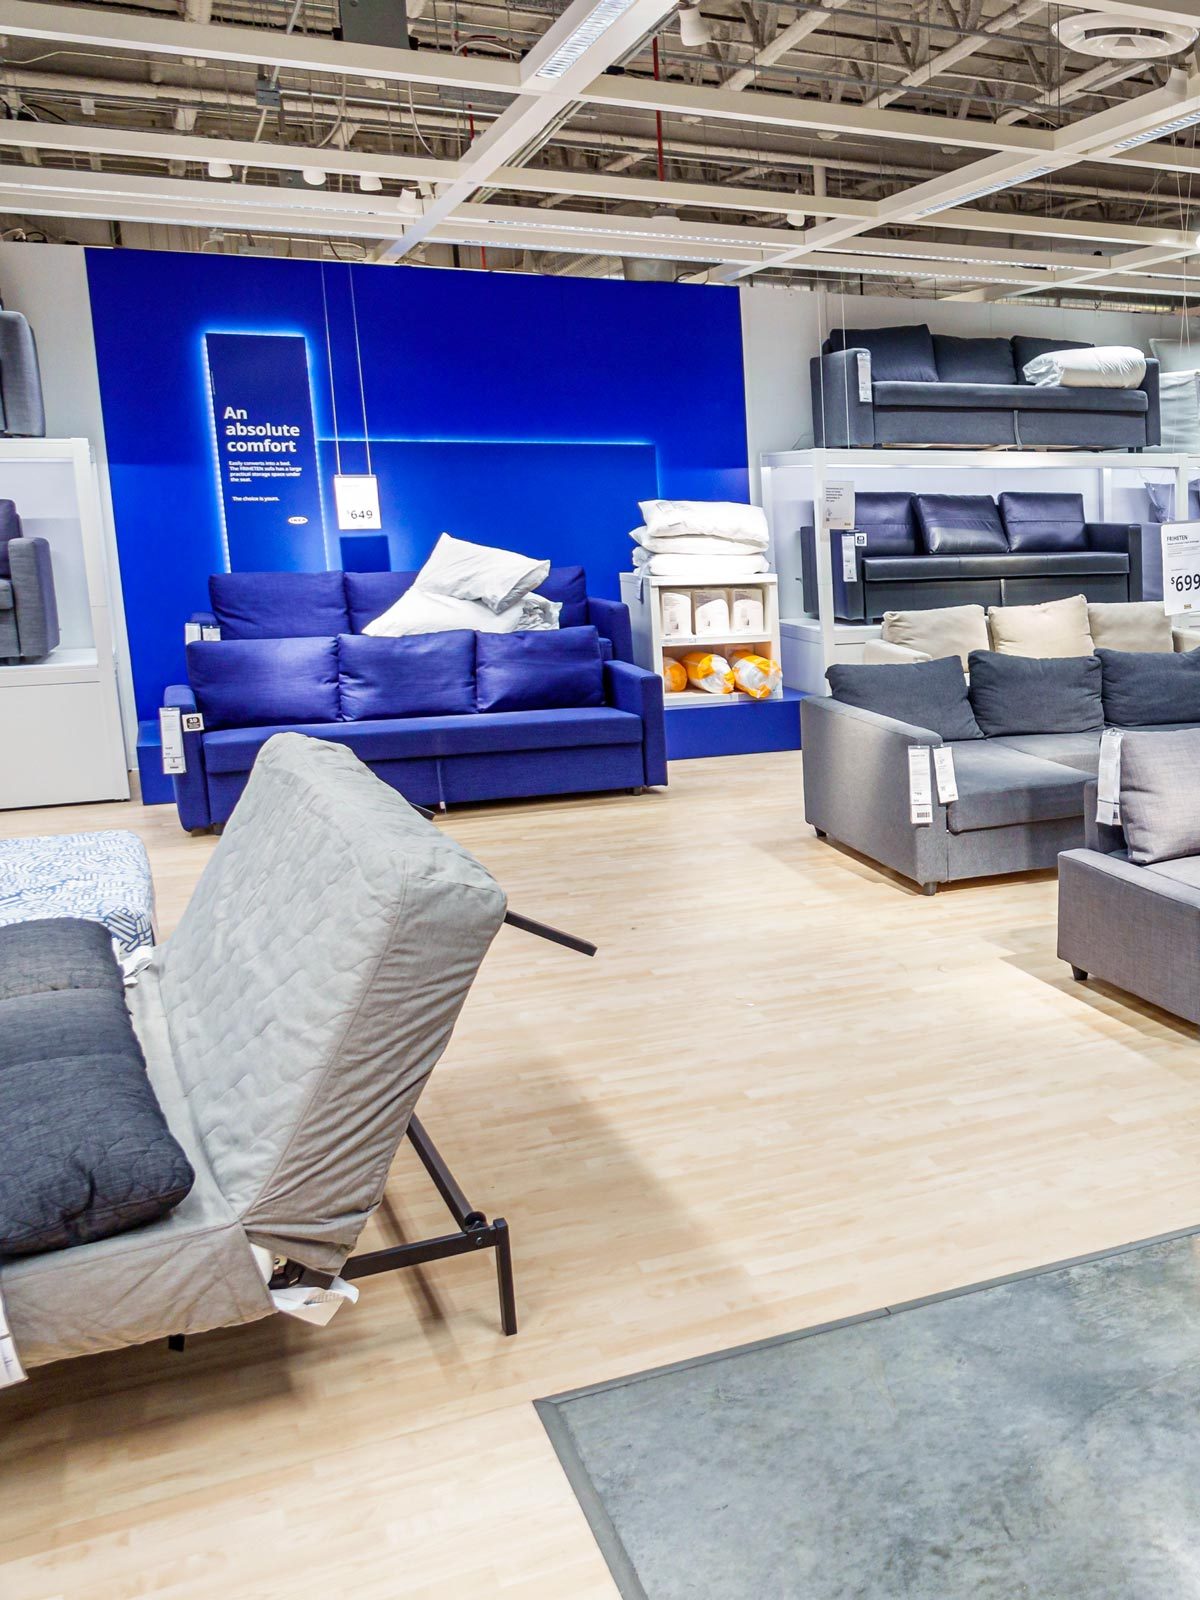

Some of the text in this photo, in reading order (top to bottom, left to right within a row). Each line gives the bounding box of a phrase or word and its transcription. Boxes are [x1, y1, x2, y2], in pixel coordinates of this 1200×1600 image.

[224, 406, 248, 419] An
[226, 423, 300, 436] absolute
[227, 439, 297, 452] comfort
